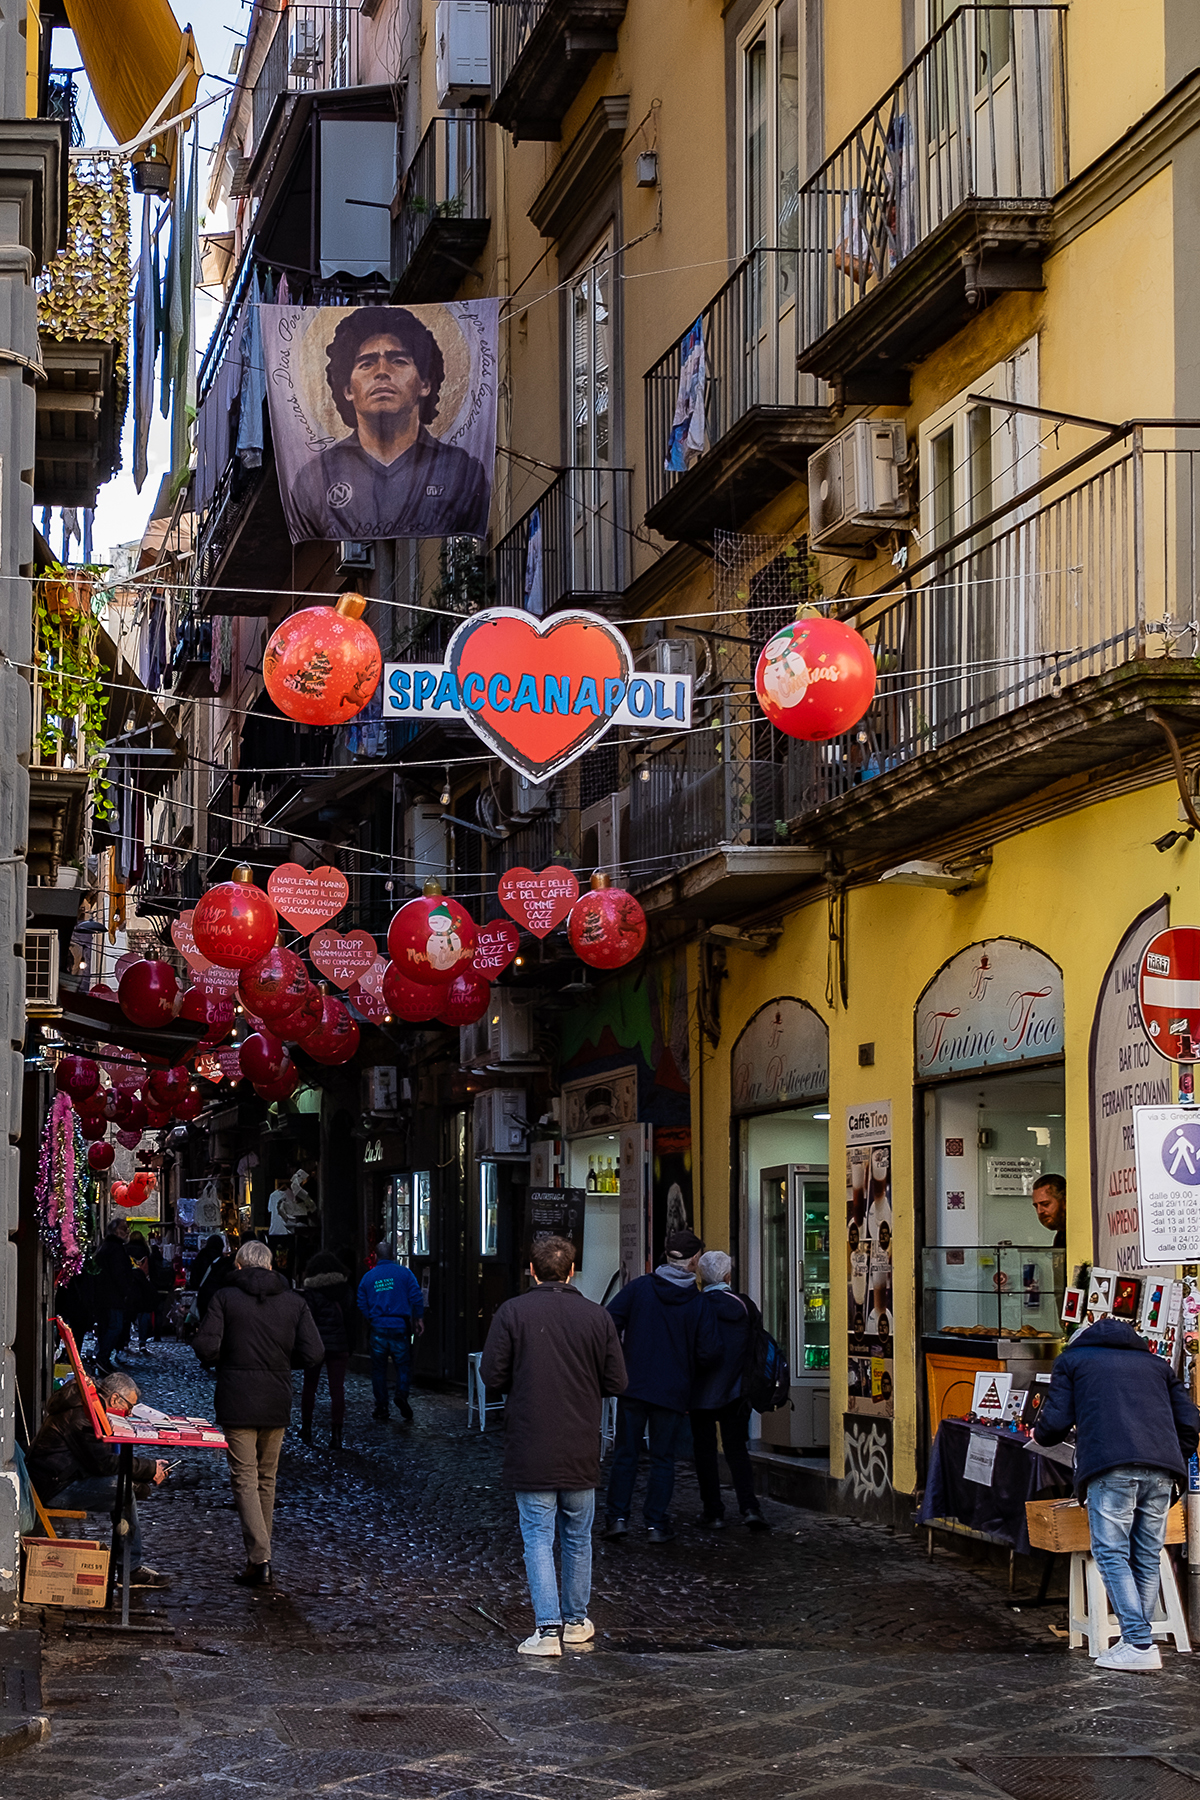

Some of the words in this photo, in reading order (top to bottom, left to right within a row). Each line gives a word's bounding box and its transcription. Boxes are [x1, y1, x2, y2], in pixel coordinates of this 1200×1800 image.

[388, 669, 685, 722] SPACCANAPOLI
[502, 880, 514, 890] LE
[515, 880, 546, 889] REGOLE
[547, 878, 574, 888] DELLE
[520, 889, 540, 900] DEL
[523, 899, 556, 911] COMME
[526, 910, 553, 920] CAZZ
[528, 919, 553, 930] COCE
[320, 940, 331, 950] SO
[1114, 969, 1121, 995] IL
[920, 1006, 997, 1068] Tonino
[1003, 985, 1059, 1051] Tico
[1119, 1047, 1132, 1073] BAR
[1133, 1041, 1150, 1069] TICO
[734, 1061, 762, 1105] Bar
[764, 1053, 827, 1099] Pasticceria
[1102, 1084, 1133, 1119] FERRANTE
[1134, 1077, 1170, 1106] GIOVANNI
[848, 1112, 870, 1131] Caffè
[870, 1110, 888, 1128] Tico
[1148, 1113, 1159, 1121] via
[1160, 1113, 1168, 1121] S.
[1149, 1192, 1168, 1200] dalle
[1170, 1191, 1193, 1199] 09.00
[1165, 1199, 1198, 1208] 29/11/24
[1150, 1209, 1164, 1217] -dal
[1167, 1217, 1177, 1225] 13
[1178, 1217, 1185, 1225] al
[1151, 1226, 1166, 1234] -dal
[1157, 1243, 1176, 1251] dalle
[1177, 1243, 1198, 1251] 09.00
